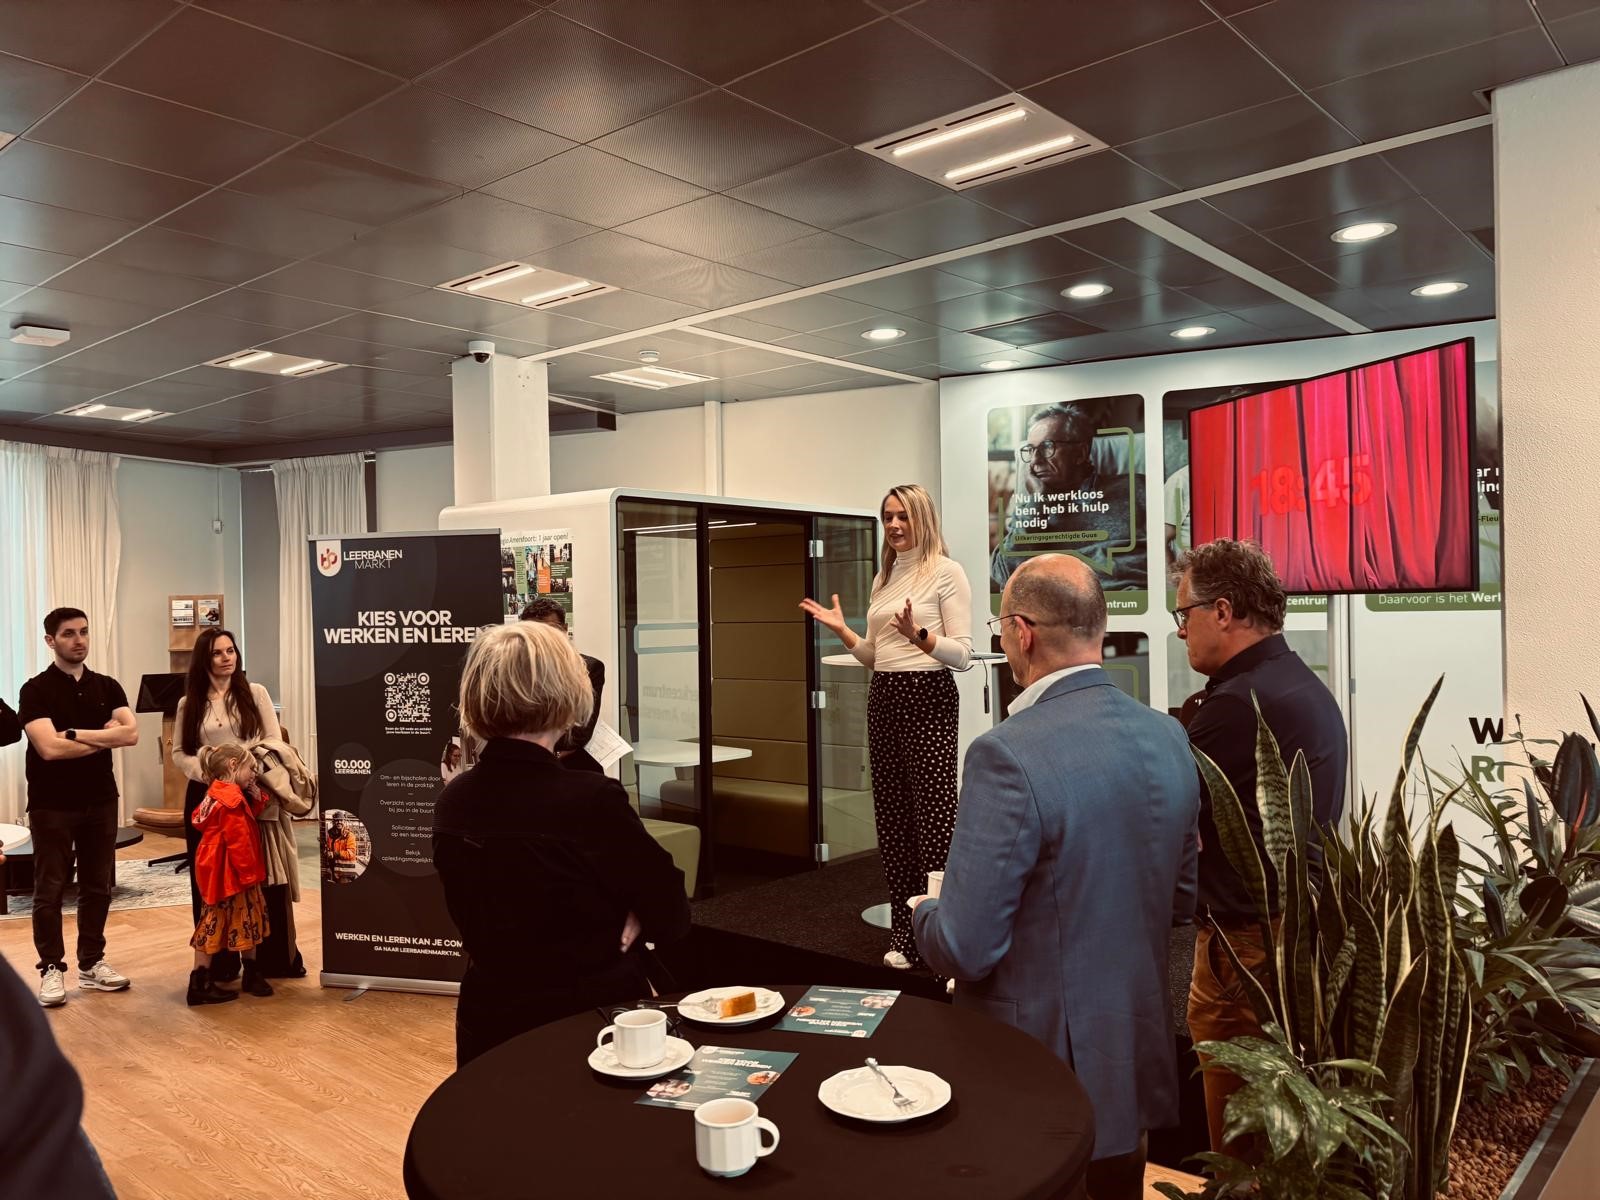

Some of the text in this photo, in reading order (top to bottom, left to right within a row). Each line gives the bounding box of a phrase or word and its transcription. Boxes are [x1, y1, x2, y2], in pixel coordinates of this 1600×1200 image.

[1251, 454, 1372, 516] 18:45
[1034, 492, 1044, 503] ik
[1047, 489, 1104, 502] werkloos
[1015, 501, 1110, 516] ben, heb ik hulp
[343, 549, 403, 561] LEERBANEN
[354, 558, 393, 570] MARKT
[1378, 593, 1432, 605] Daarvoor
[1435, 593, 1446, 603] is
[1449, 592, 1469, 604] het
[358, 610, 452, 626] KIES VOOR
[323, 628, 399, 644] WERKEN
[402, 628, 428, 644] EN
[335, 759, 371, 769] 60.000
[335, 932, 370, 942] WERKEN
[371, 934, 383, 942] EN
[384, 936, 411, 944] LEREN
[412, 937, 430, 946] KAN
[432, 938, 443, 946] JE
[400, 947, 461, 957] LEERBANENMARKT.NL
